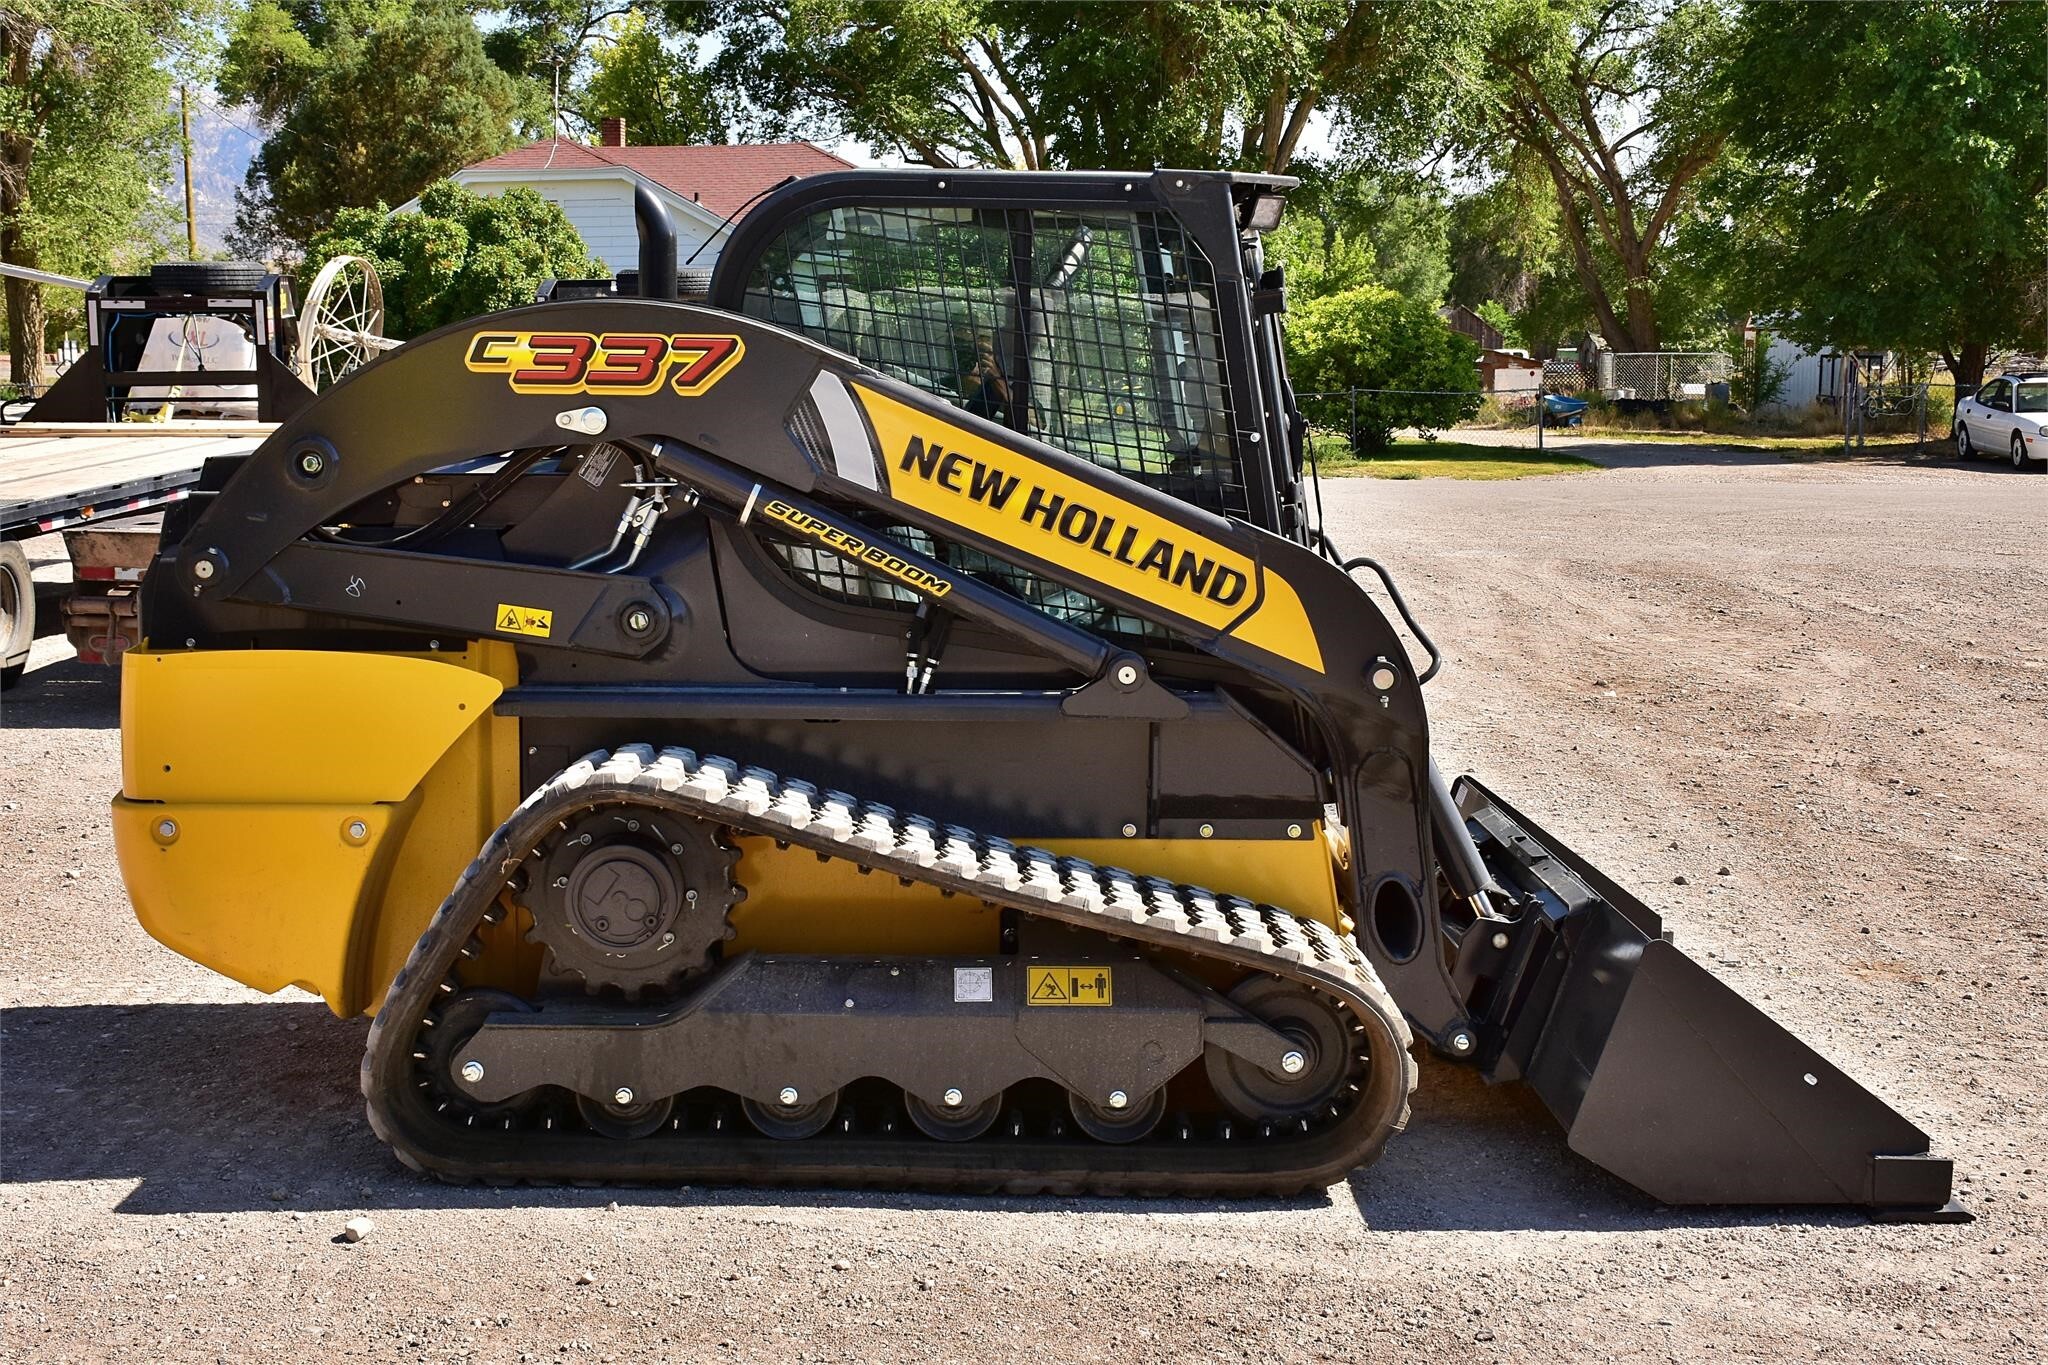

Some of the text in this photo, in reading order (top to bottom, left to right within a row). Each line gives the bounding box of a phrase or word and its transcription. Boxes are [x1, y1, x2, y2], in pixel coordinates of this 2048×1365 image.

[465, 331, 745, 396] C337
[764, 501, 951, 597] SUPER BOOM
[899, 434, 1248, 608] NEW HOLLAND
